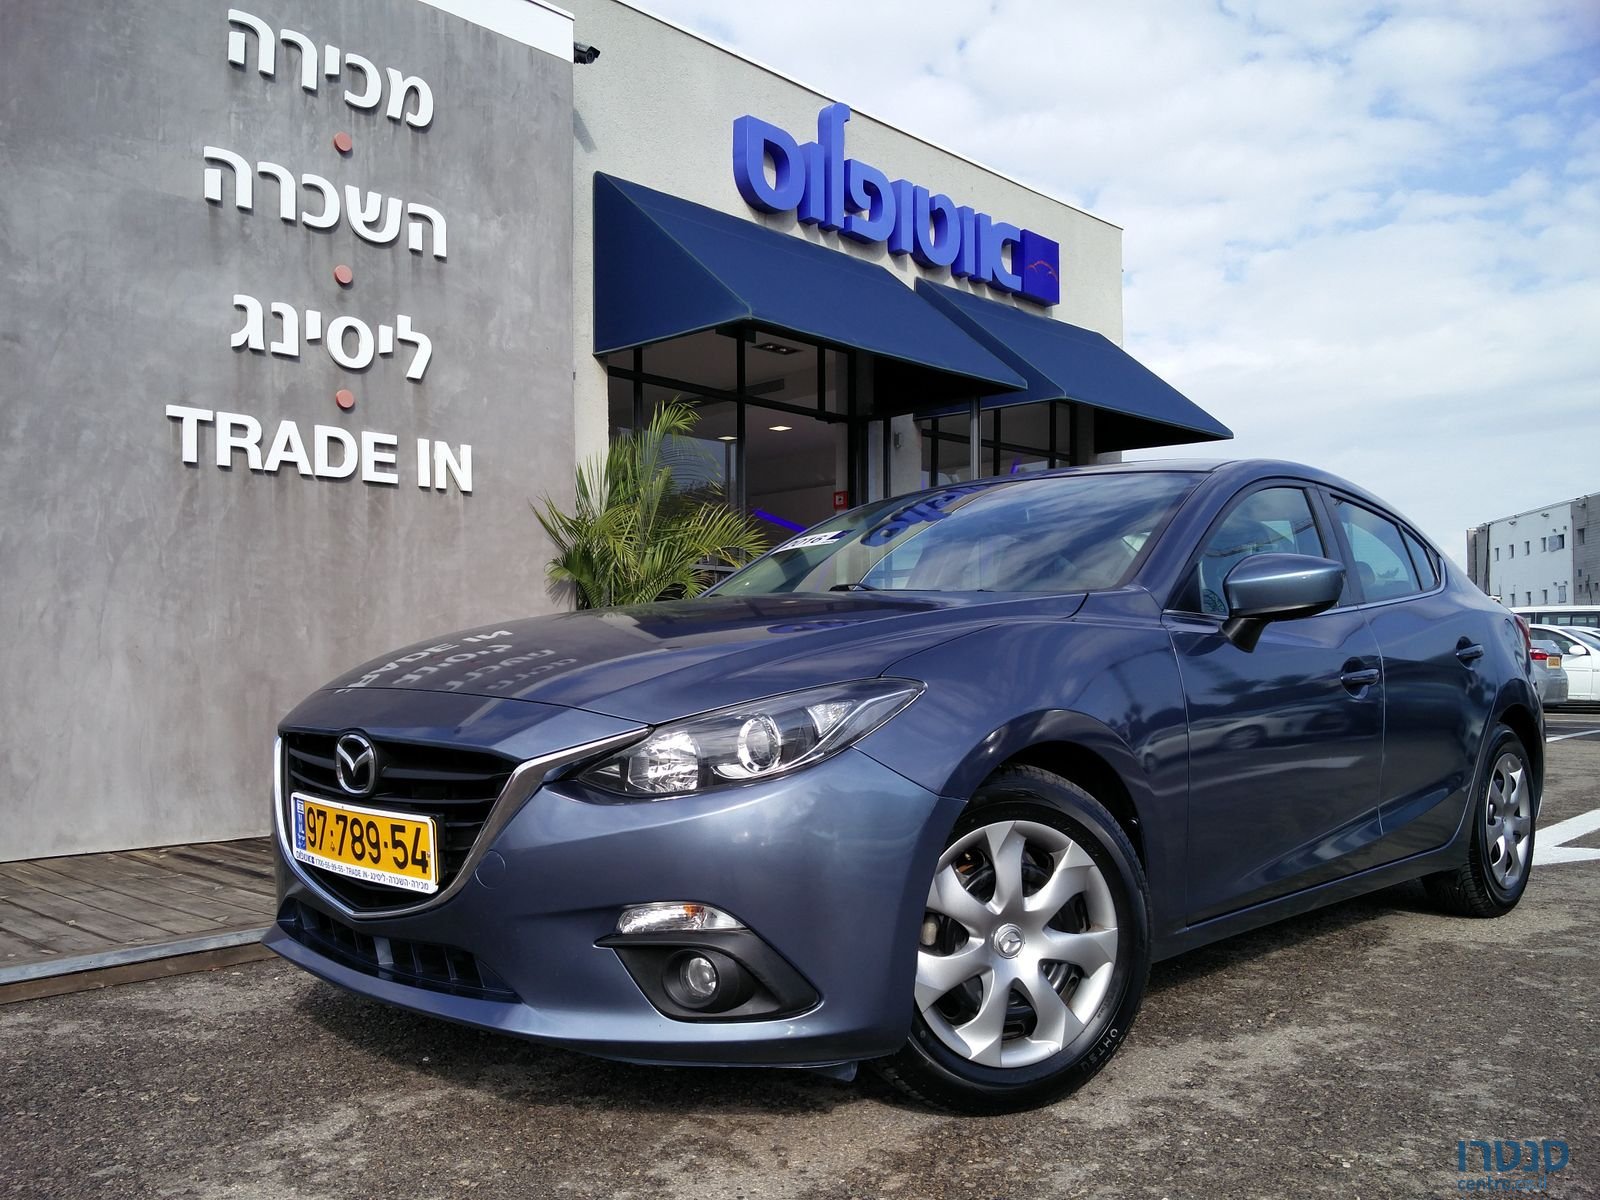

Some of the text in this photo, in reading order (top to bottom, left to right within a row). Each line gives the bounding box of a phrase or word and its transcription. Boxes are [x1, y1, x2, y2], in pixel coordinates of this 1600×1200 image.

[227, 8, 434, 127] מכירה
[203, 145, 447, 258] השכרה
[732, 102, 1022, 294] אוטופלוס
[230, 293, 433, 380] ליסינג
[165, 404, 473, 492] TRADE IN
